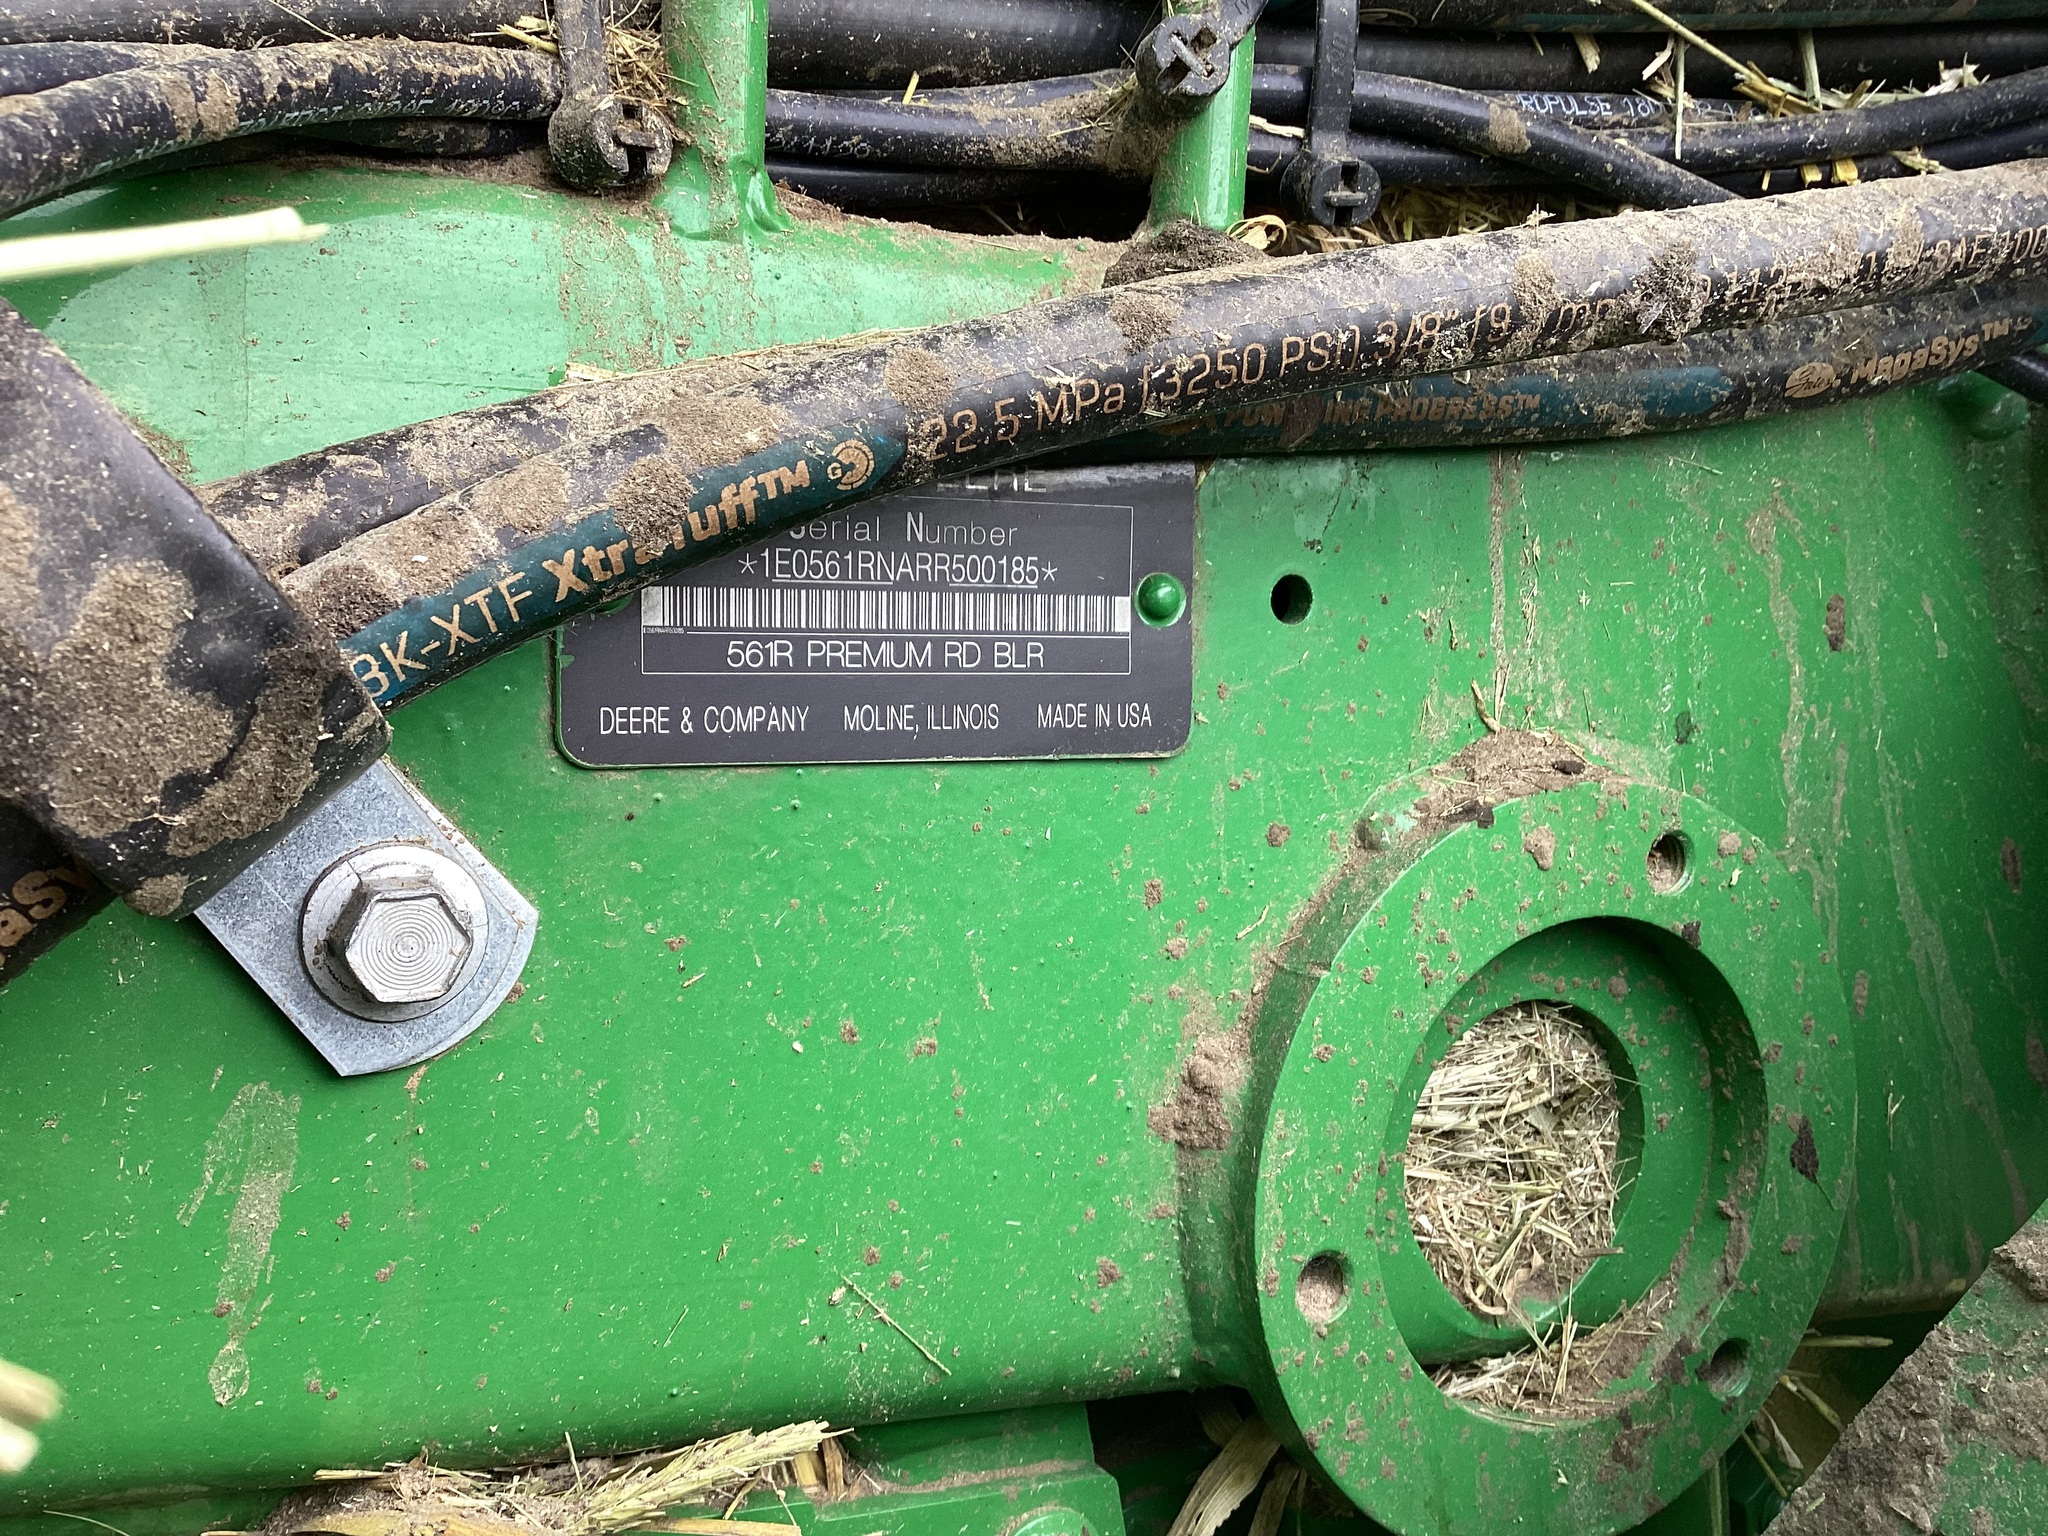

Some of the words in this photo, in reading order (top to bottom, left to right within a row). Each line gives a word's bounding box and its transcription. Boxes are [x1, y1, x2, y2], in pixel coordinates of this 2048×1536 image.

[1034, 379, 1124, 432] MPa
[906, 511, 1018, 546] Number
[726, 639, 794, 668] 561R
[806, 639, 932, 669] PREMIUM
[944, 640, 982, 669] RD
[993, 640, 1045, 669] BLR
[599, 705, 671, 735] DEERE
[680, 704, 694, 734] &
[703, 704, 810, 734] COMPANY
[843, 703, 920, 733] MOLINE,
[926, 703, 1000, 731] ILLINOIS
[1037, 702, 1088, 729] MADE
[1095, 703, 1111, 728] IN
[1118, 702, 1153, 729] USA
